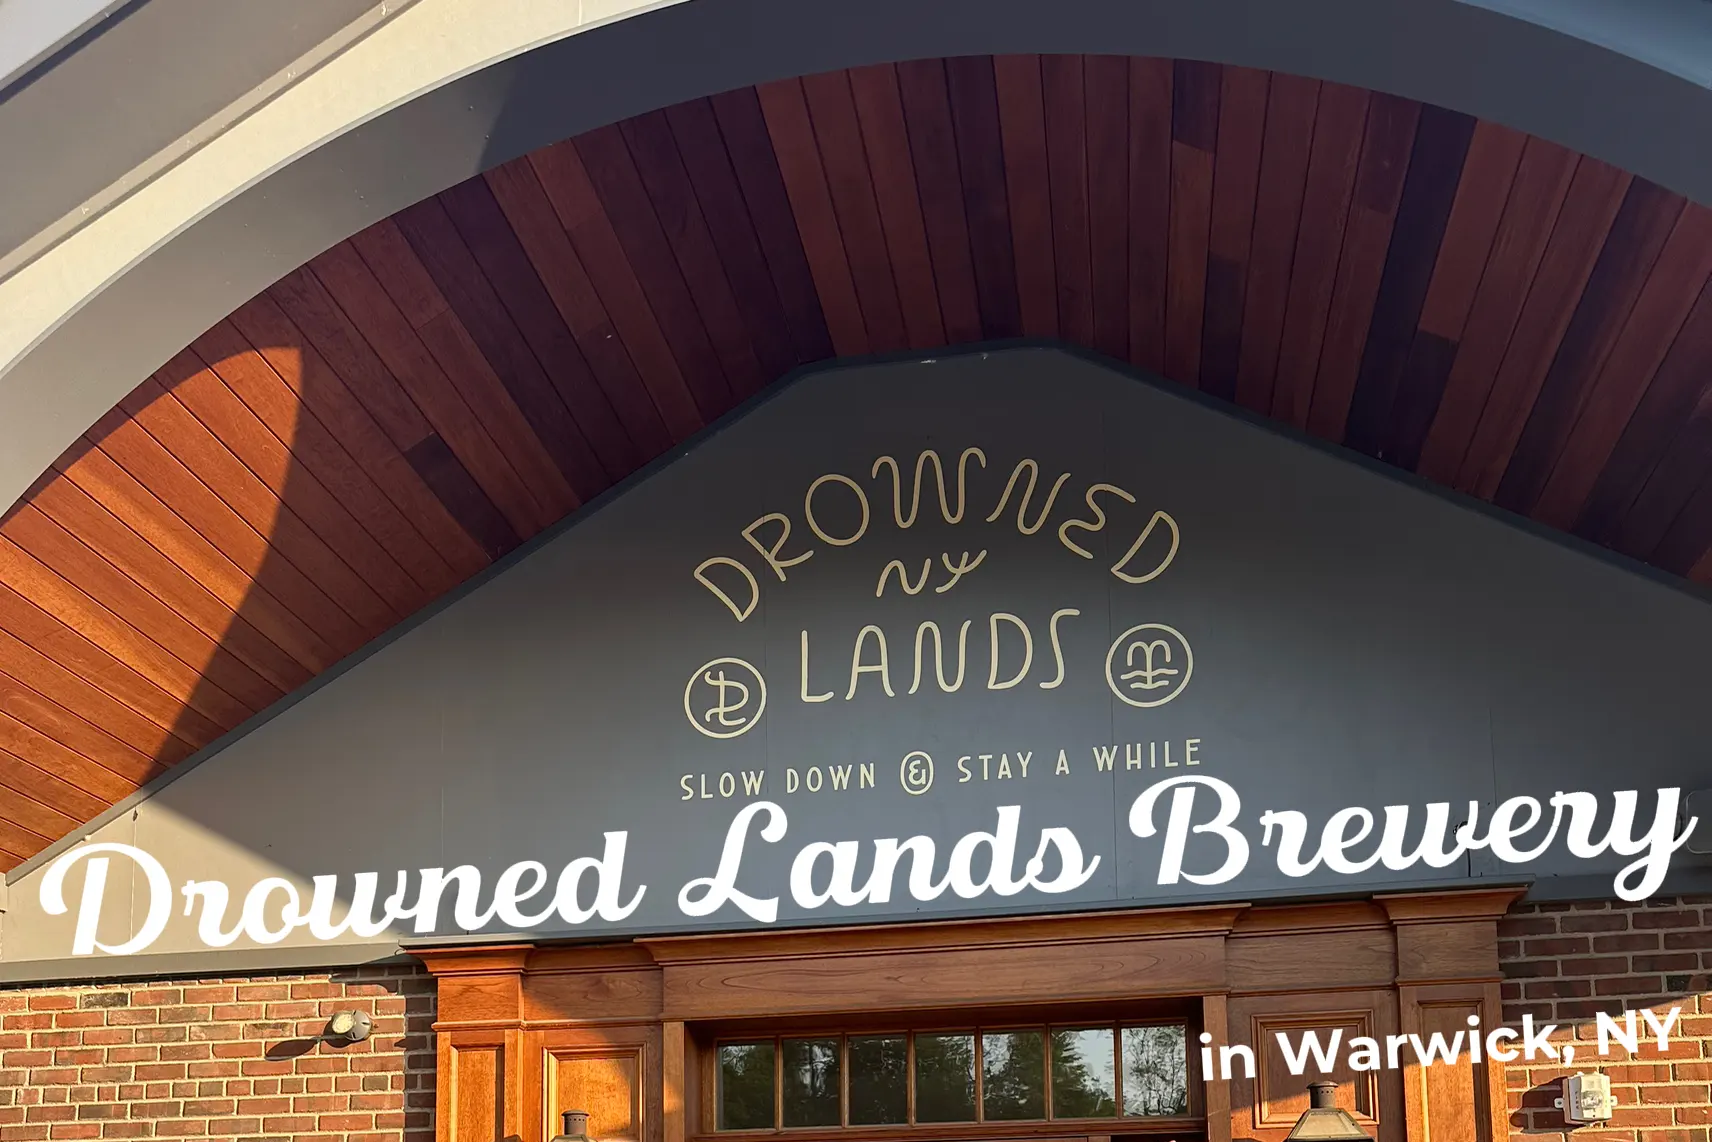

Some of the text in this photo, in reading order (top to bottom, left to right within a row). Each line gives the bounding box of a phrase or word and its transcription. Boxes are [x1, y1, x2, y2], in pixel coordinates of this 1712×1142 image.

[694, 447, 1180, 623] DROWNED
[876, 549, 987, 598] NY
[800, 608, 1081, 703] LANDS
[680, 769, 765, 801] SLOW
[786, 761, 876, 794] DOWN
[957, 750, 1033, 783] STAY
[1055, 748, 1070, 776] A
[1092, 738, 1201, 773] WHILE
